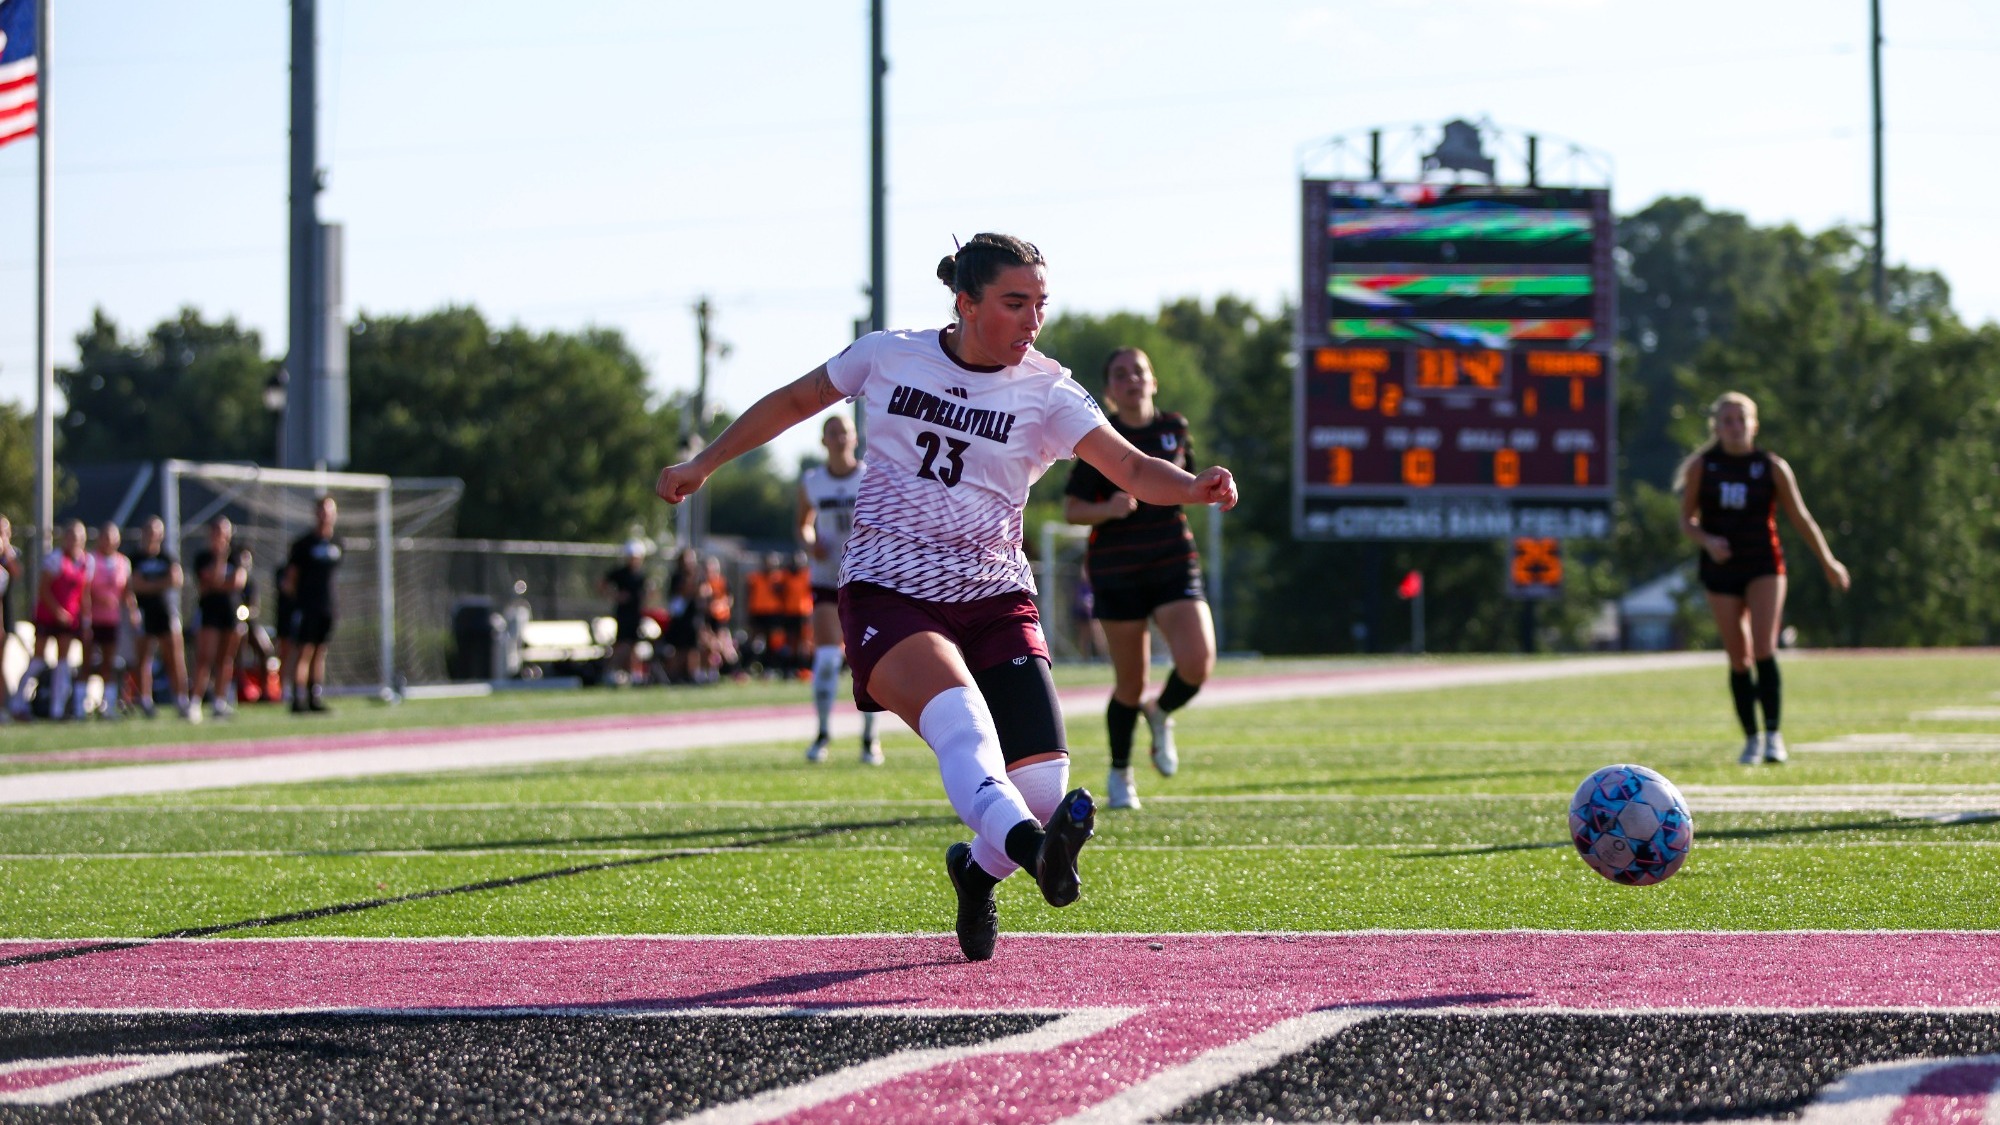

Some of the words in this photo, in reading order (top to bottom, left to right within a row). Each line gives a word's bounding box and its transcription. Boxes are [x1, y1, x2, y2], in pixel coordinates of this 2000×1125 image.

[888, 385, 1016, 444] CAMPBELLSVILLE
[916, 431, 971, 487] 23
[1335, 508, 1443, 535] CITIZENS
[1449, 509, 1513, 536] BANK
[1519, 509, 1584, 536] FIELD
